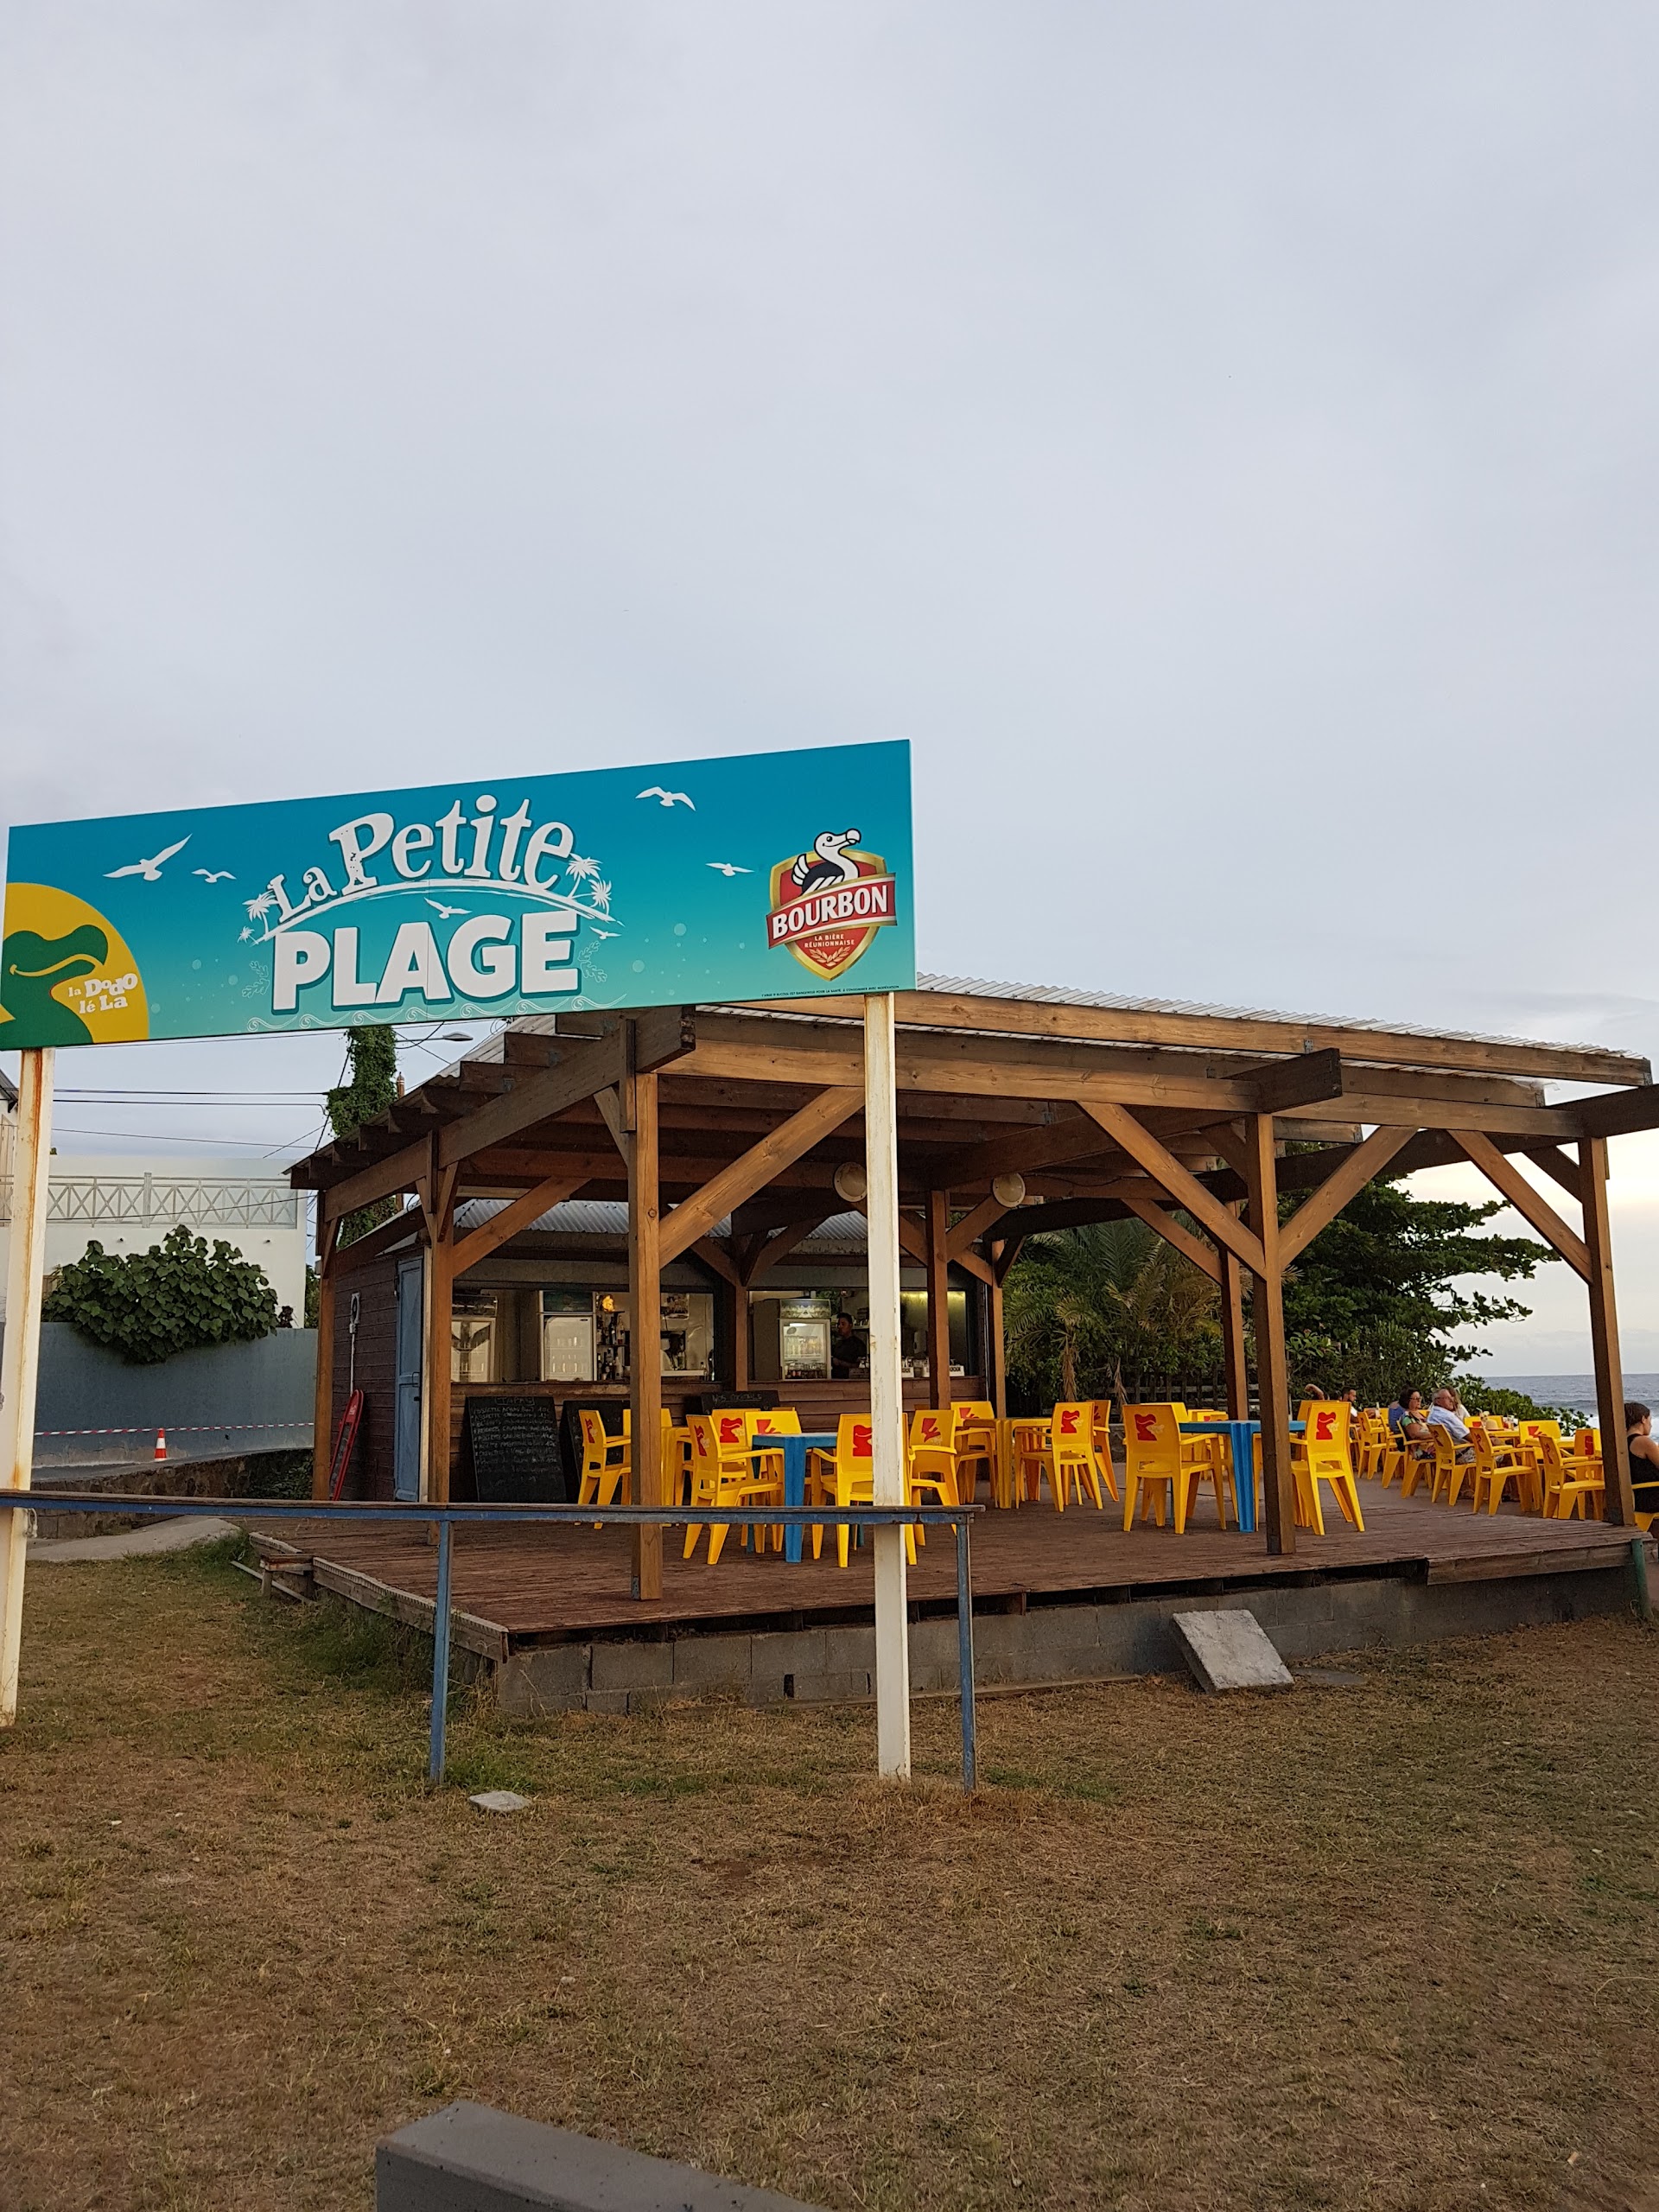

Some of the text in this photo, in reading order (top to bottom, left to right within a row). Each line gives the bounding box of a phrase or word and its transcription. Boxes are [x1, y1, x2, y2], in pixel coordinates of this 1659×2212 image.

[267, 794, 574, 923] La Petite
[772, 885, 888, 939] BOURBON
[804, 938, 855, 949] RÉUNIONNAISE
[824, 932, 845, 941] BIÈRE
[272, 910, 579, 1011] PLAGE
[68, 987, 82, 997] la
[79, 995, 129, 1014] lé La
